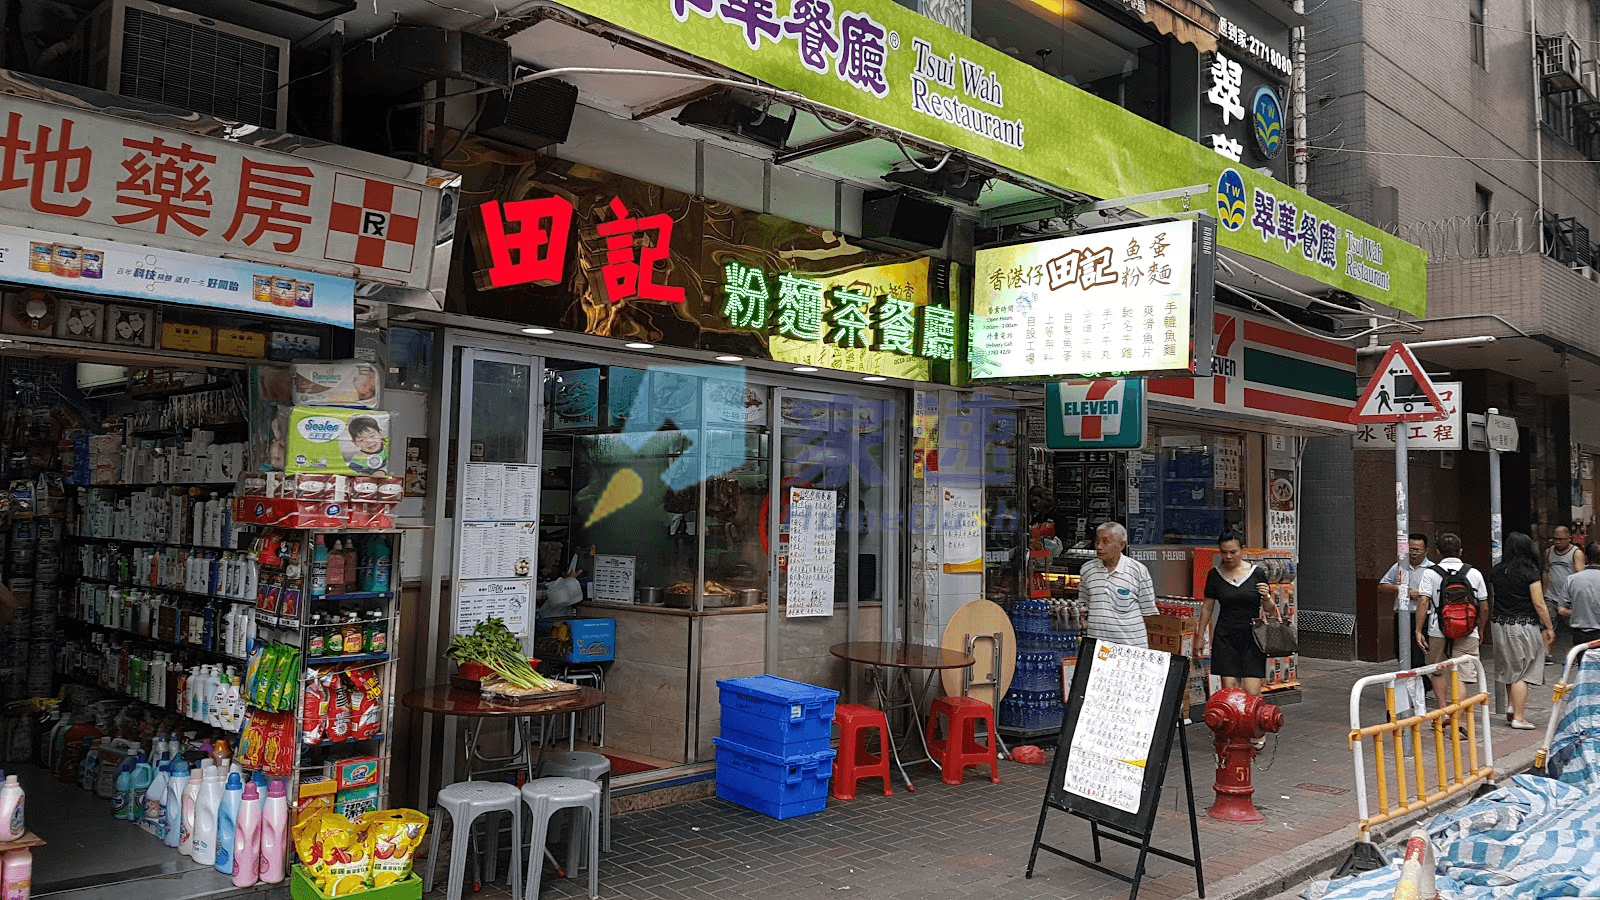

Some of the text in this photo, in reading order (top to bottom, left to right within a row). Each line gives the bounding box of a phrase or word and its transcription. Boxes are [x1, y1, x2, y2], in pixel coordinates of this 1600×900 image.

[676, 0, 887, 94] 華餐廳
[913, 38, 1003, 106] Tsui Wah
[912, 79, 1024, 149] Restaurant
[0, 112, 314, 253] 地藥房
[1225, 183, 1240, 197] TW
[1253, 190, 1336, 269] 翠華餐廳
[480, 194, 686, 303] 田記
[1123, 232, 1171, 262] 魚蛋
[1346, 231, 1383, 264] Tsui Wah
[989, 246, 1118, 291] 香港仔 田記
[1121, 263, 1172, 288] 粉麵
[1346, 254, 1390, 290] Restaurant
[1026, 316, 1036, 364] 自設工場
[1212, 356, 1236, 378] EVEN
[1064, 400, 1119, 416] ELEVEN
[1131, 551, 1157, 561] 7-ELEVEN
[1161, 551, 1186, 561] 7-ELEVEN
[1149, 633, 1175, 646] TTE
[1236, 767, 1249, 781] 51
